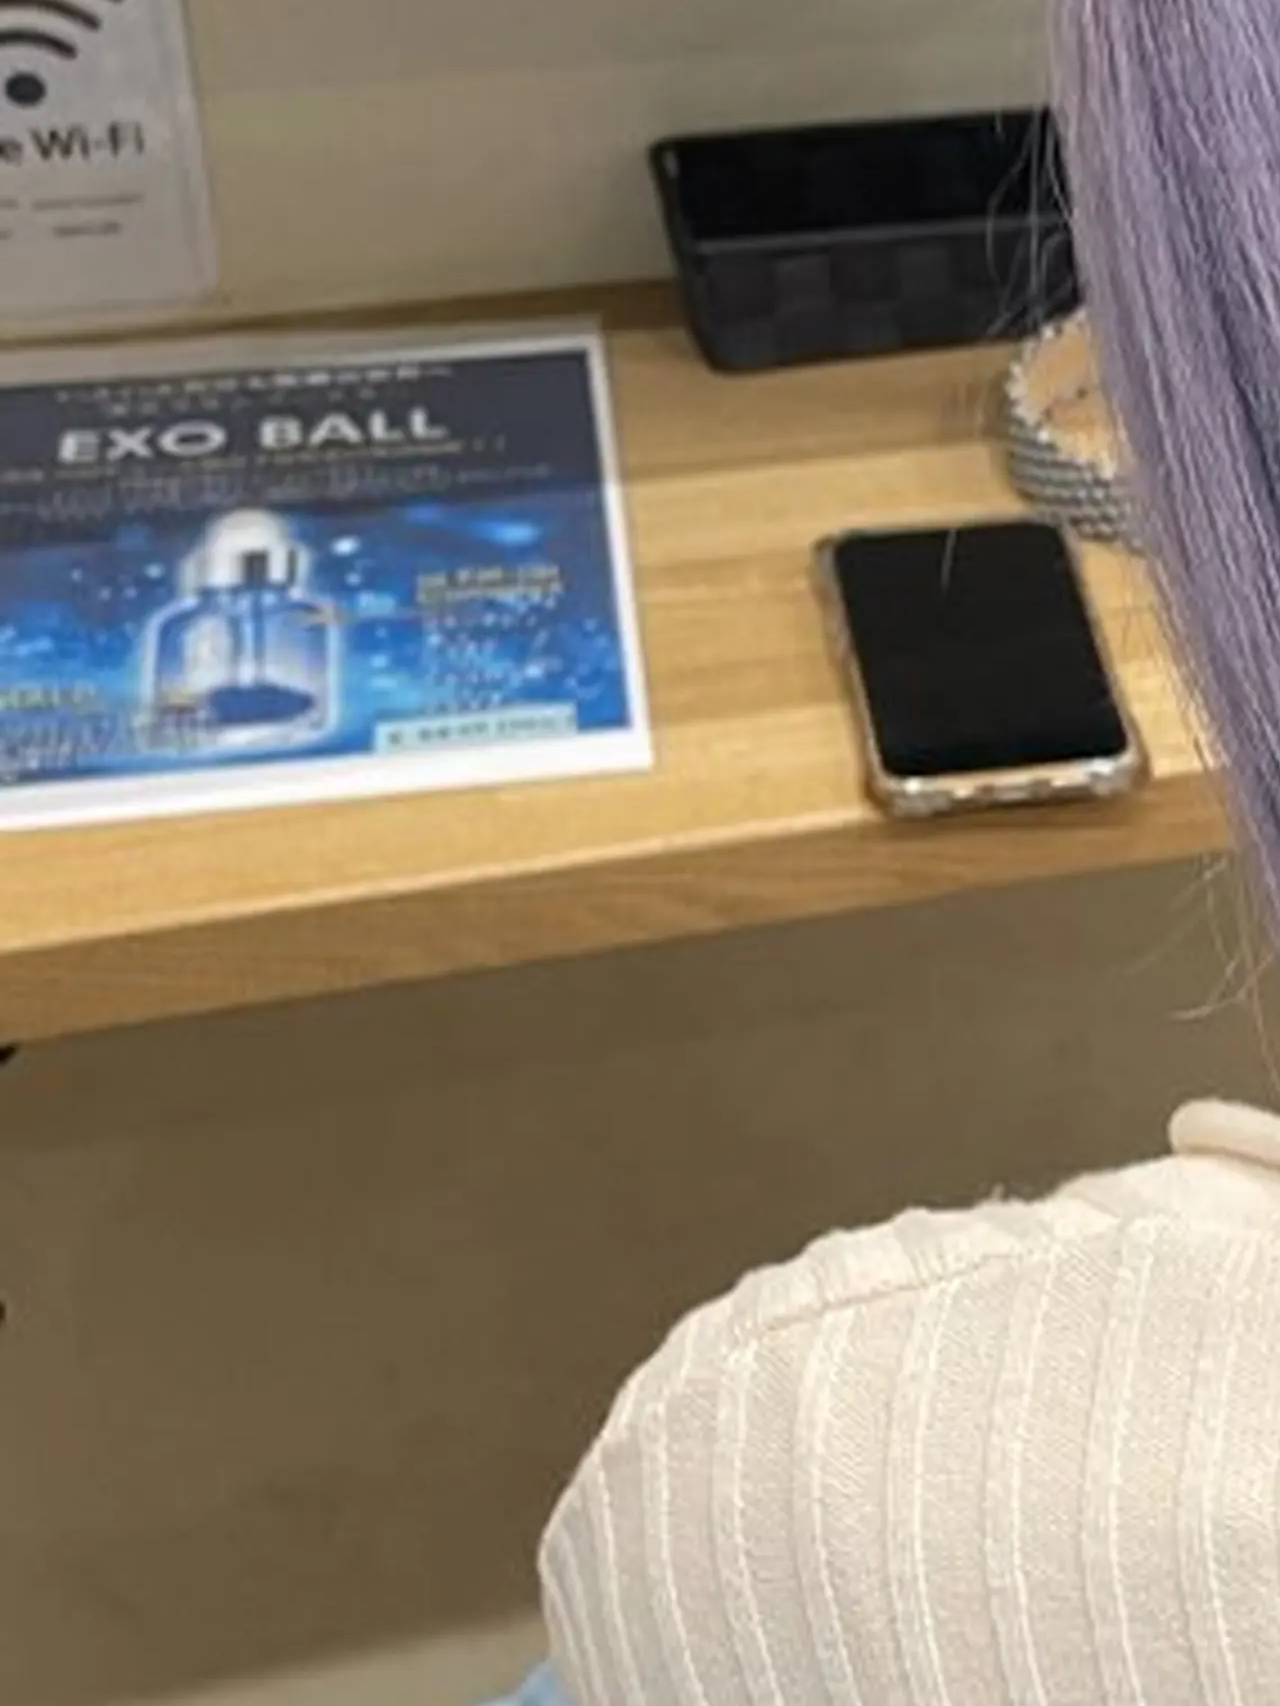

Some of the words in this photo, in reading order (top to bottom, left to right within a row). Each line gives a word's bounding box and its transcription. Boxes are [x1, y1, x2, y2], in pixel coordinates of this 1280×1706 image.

[30, 122, 145, 163] Wi-Fi
[58, 419, 227, 464] EXO
[258, 406, 449, 451] BALL
